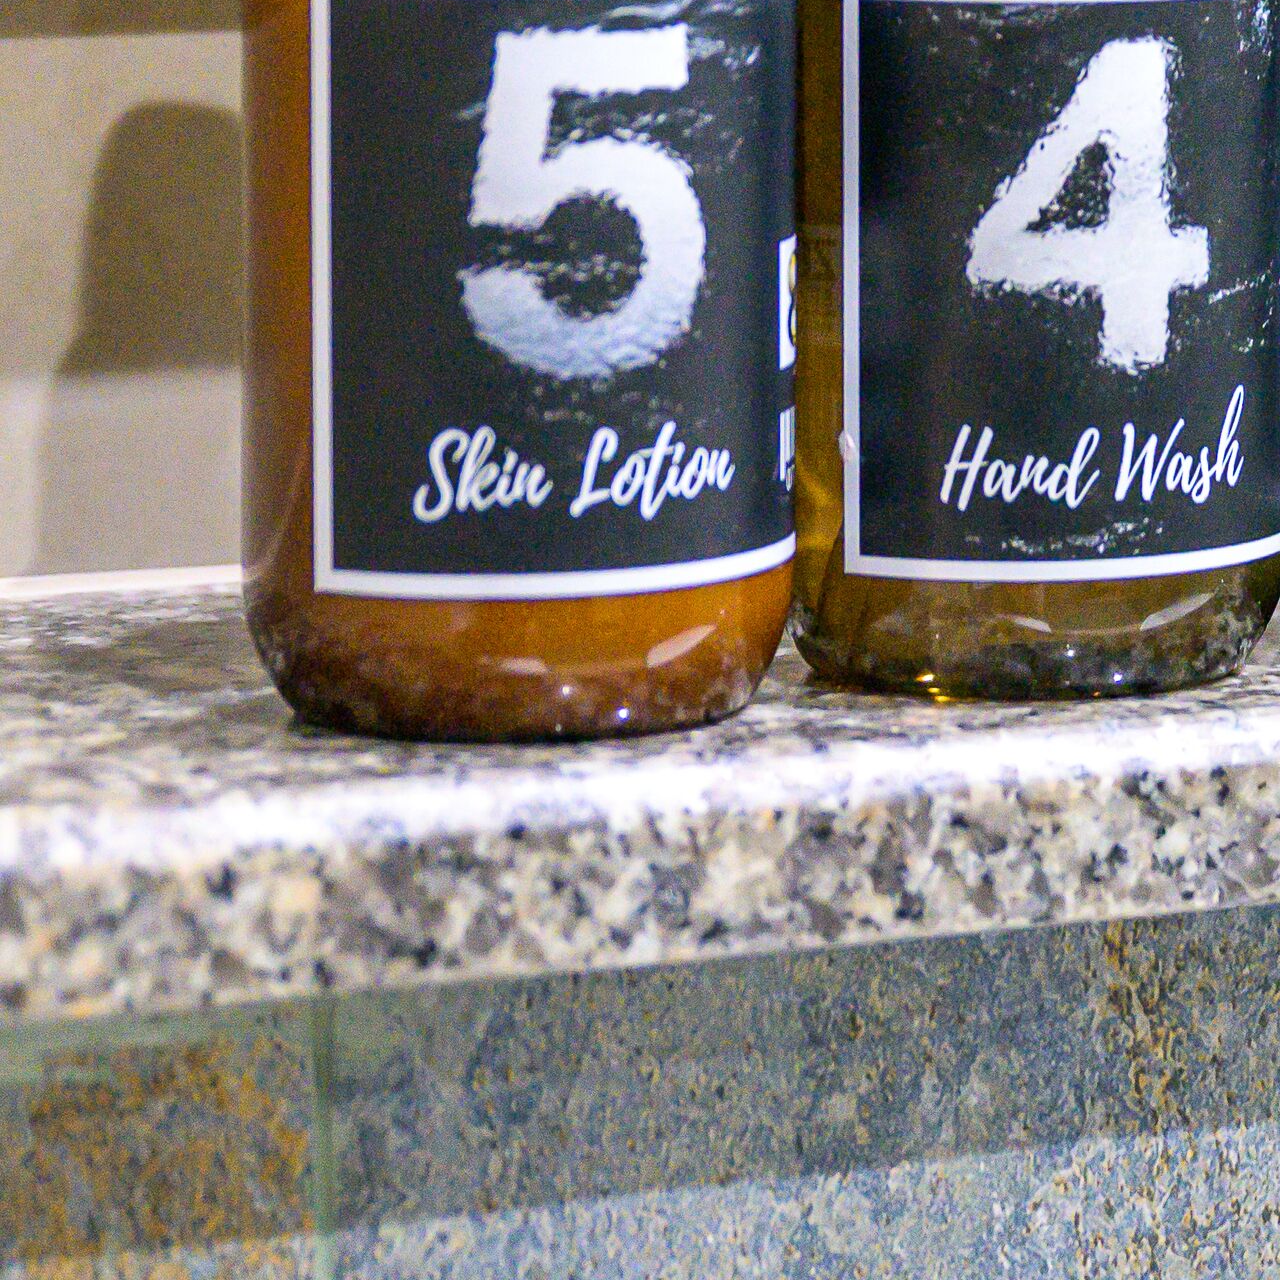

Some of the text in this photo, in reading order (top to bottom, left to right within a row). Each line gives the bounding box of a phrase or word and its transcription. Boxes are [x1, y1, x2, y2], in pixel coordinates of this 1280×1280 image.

[459, 24, 708, 379] 5
[966, 34, 1211, 375] 4
[413, 420, 736, 522] Skin Lotion
[939, 384, 1245, 512] Hand Wash
